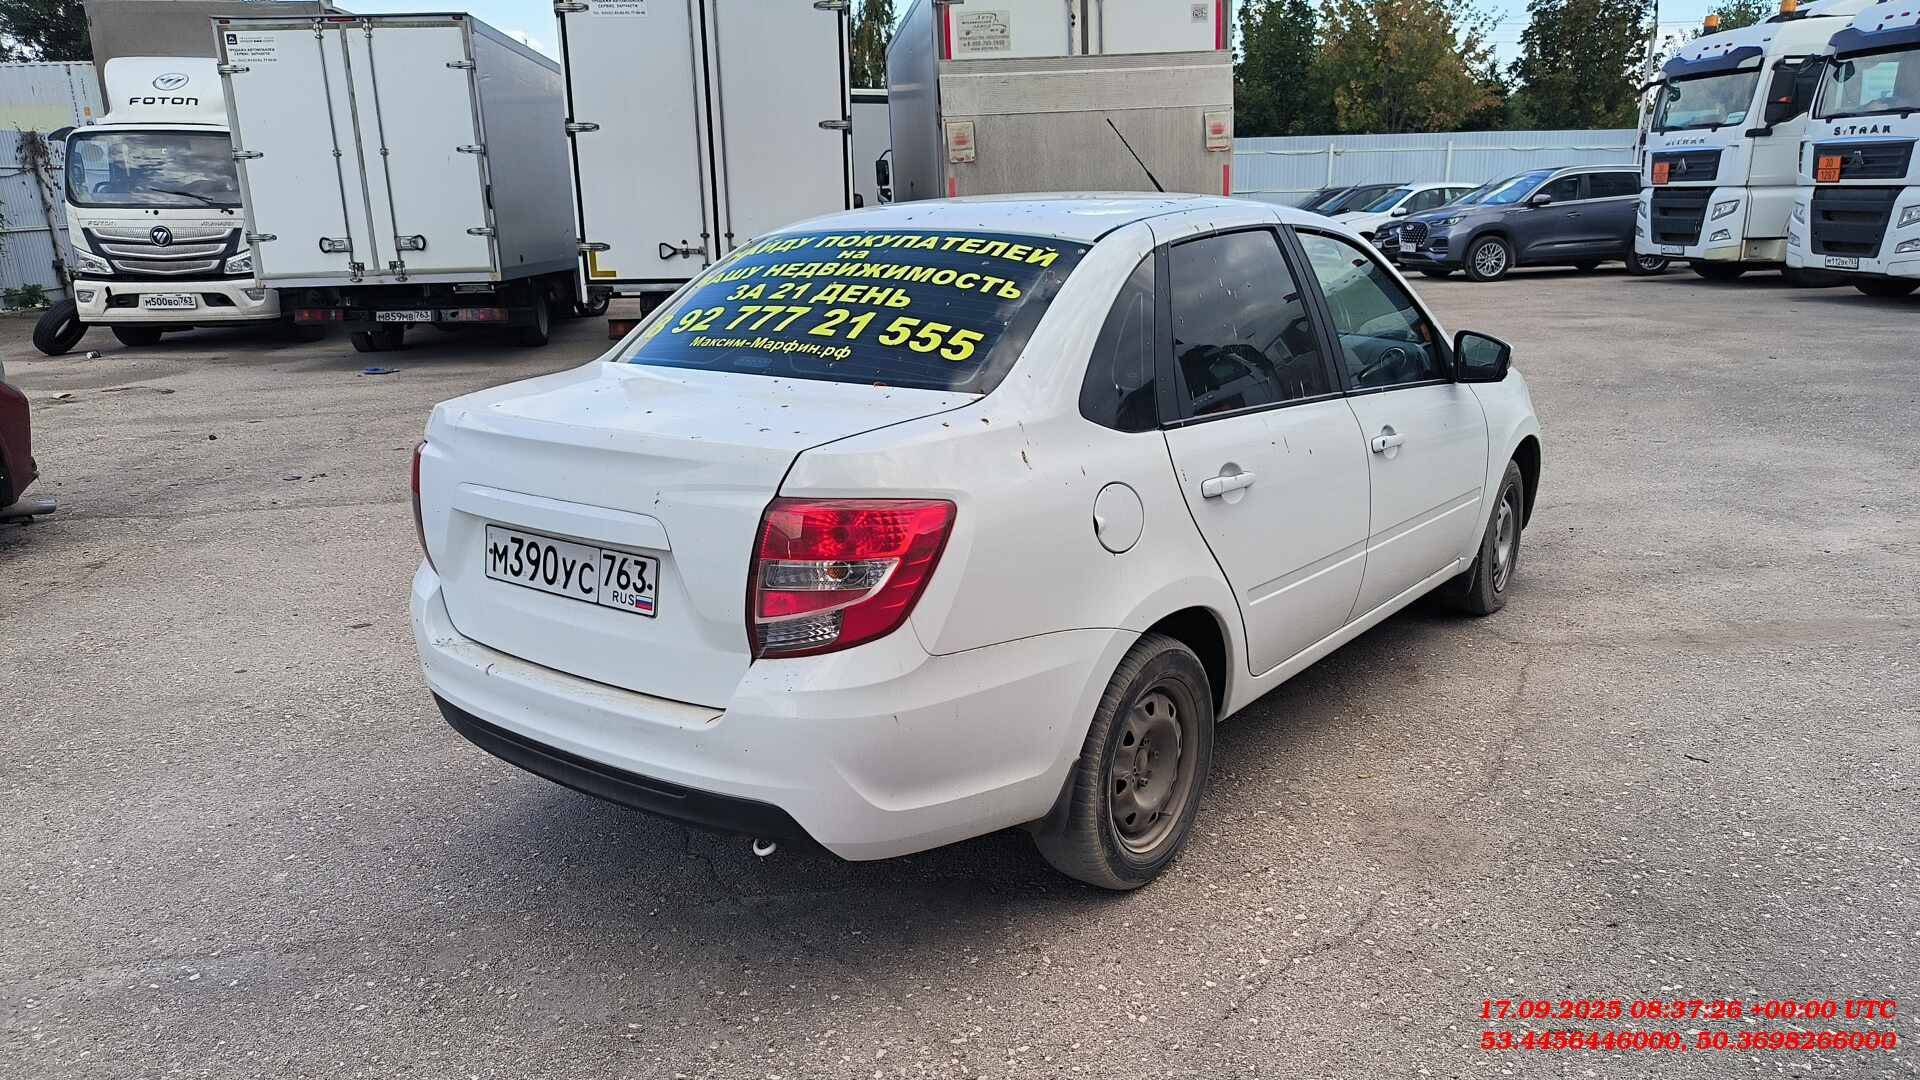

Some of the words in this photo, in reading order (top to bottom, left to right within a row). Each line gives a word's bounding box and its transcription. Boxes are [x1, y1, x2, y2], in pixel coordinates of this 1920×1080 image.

[129, 97, 199, 106] FOTON
[814, 235, 1060, 268] ПОКУПАТЕЛЕЙ
[836, 249, 870, 260] на
[762, 262, 1023, 300] НЕДВИЖИМОСТЬ
[727, 284, 767, 301] ЗА
[767, 282, 813, 300] 21
[808, 282, 911, 308] ДЕНЬ
[671, 306, 725, 334] 92
[724, 305, 813, 332] 777
[807, 308, 877, 340] 21
[878, 316, 985, 361] 555
[689, 336, 852, 360] Максим-Марфин.рф
[492, 536, 595, 594] М390УС
[602, 554, 648, 593] 763
[612, 590, 635, 606] RUS
